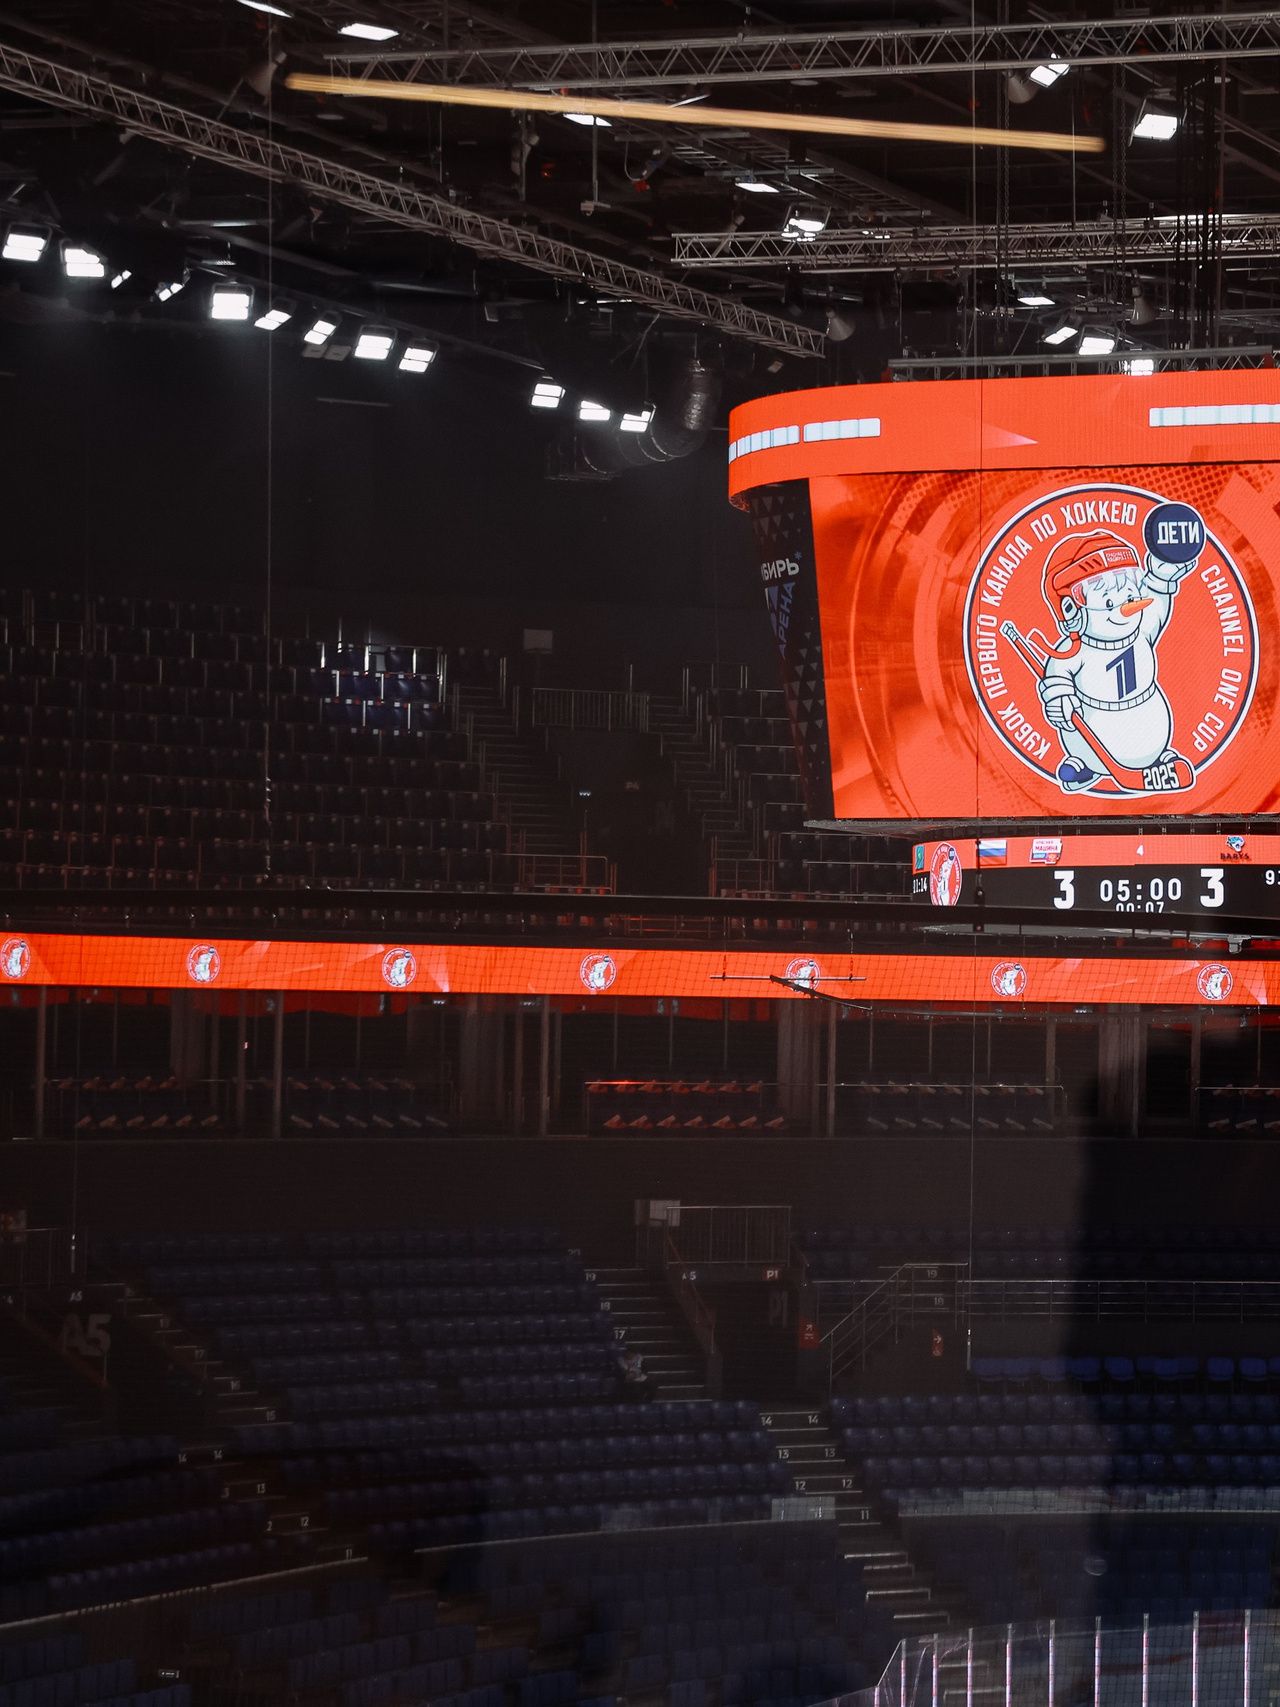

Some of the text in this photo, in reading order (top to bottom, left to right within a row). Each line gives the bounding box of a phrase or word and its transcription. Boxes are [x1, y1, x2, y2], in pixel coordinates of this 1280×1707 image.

[1157, 521, 1200, 545] ДЕТИ
[761, 557, 800, 581] БИРЬ
[777, 581, 796, 660] АРЕНА
[977, 501, 1138, 760] КУБОК ПЕРВОГО КАНАЛА ПО ХОККЕЮ
[1191, 565, 1244, 753] CHANNEL ONE CUP
[1142, 764, 1180, 790] 2025
[1136, 845, 1144, 856] 4
[1053, 870, 1075, 909] 3
[1100, 878, 1182, 902] 05:00
[1200, 868, 1224, 907] 3
[585, 1272, 596, 1282] 19
[766, 1270, 779, 1279] P1
[60, 1312, 112, 1357] A5
[614, 1329, 626, 1340] 17
[266, 1410, 276, 1421] 15
[761, 1416, 772, 1426] 14
[807, 1414, 819, 1425] 14
[778, 1449, 790, 1459] 13
[824, 1448, 836, 1458] 13
[795, 1480, 806, 1491] 12
[841, 1478, 853, 1489] 12
[860, 1510, 870, 1520] 11
[346, 1549, 353, 1560] 11
